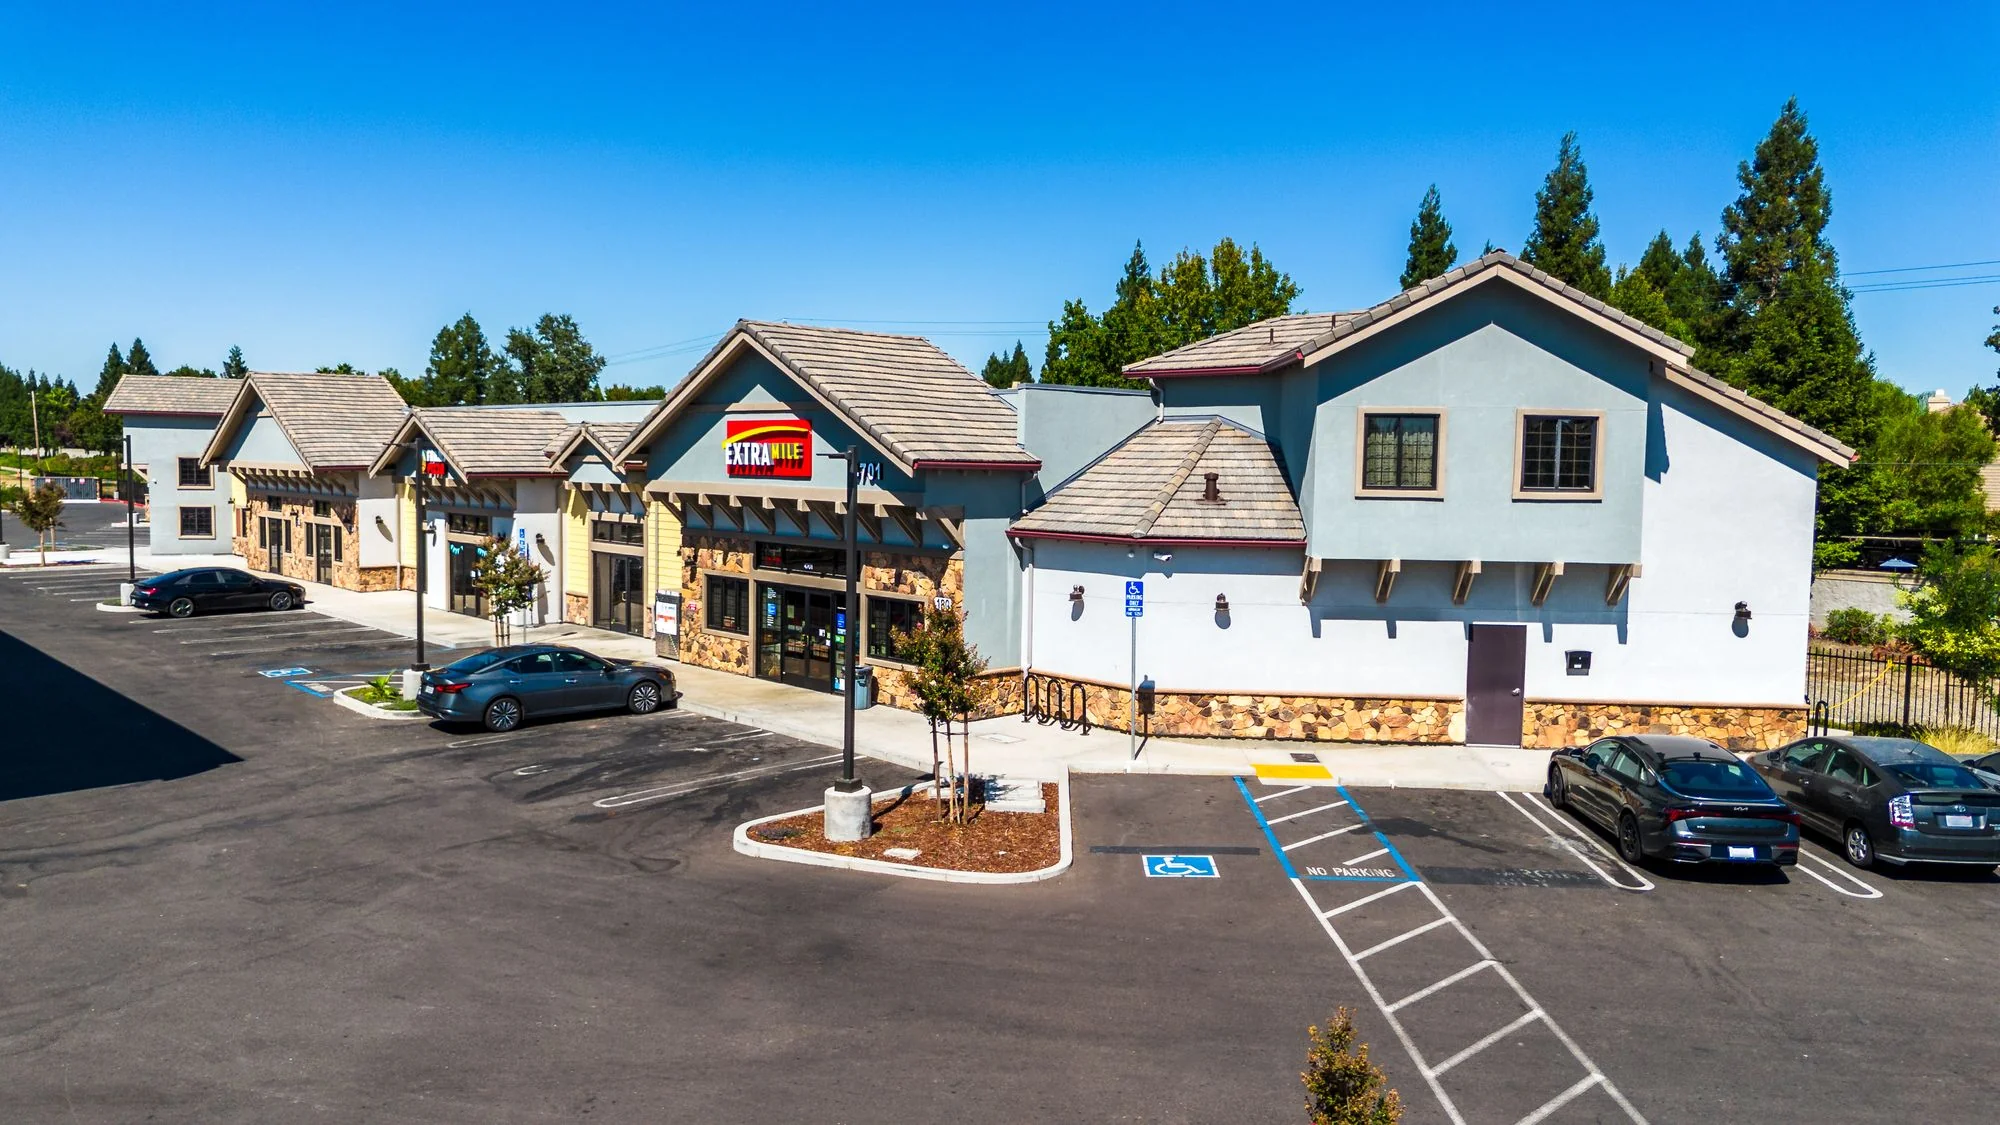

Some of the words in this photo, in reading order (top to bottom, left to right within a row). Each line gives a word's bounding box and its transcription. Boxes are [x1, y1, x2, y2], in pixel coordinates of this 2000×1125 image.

[856, 462, 881, 481] 701
[1305, 866, 1327, 876] NO
[1332, 867, 1396, 878] PARKING
